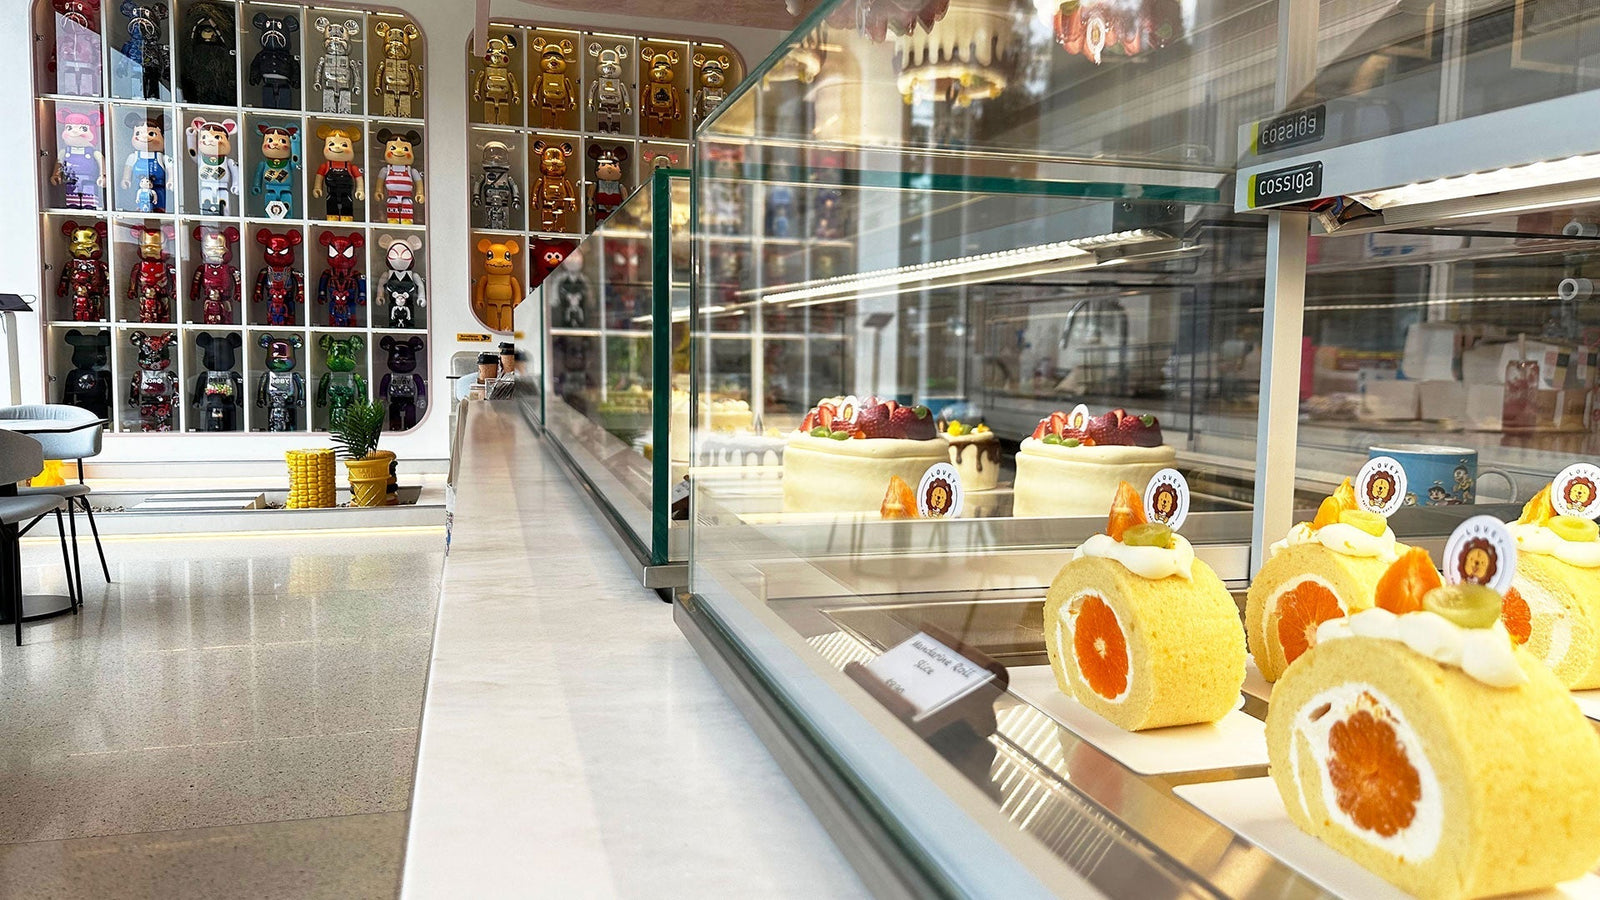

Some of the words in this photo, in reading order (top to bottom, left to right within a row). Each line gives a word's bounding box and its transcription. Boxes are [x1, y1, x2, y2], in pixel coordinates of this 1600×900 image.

[1259, 171, 1314, 196] cossiga
[930, 469, 956, 484] LOVEY
[1371, 463, 1399, 475] LOVEY
[1157, 474, 1181, 488] LOVEY
[1465, 524, 1504, 544] LOVEY
